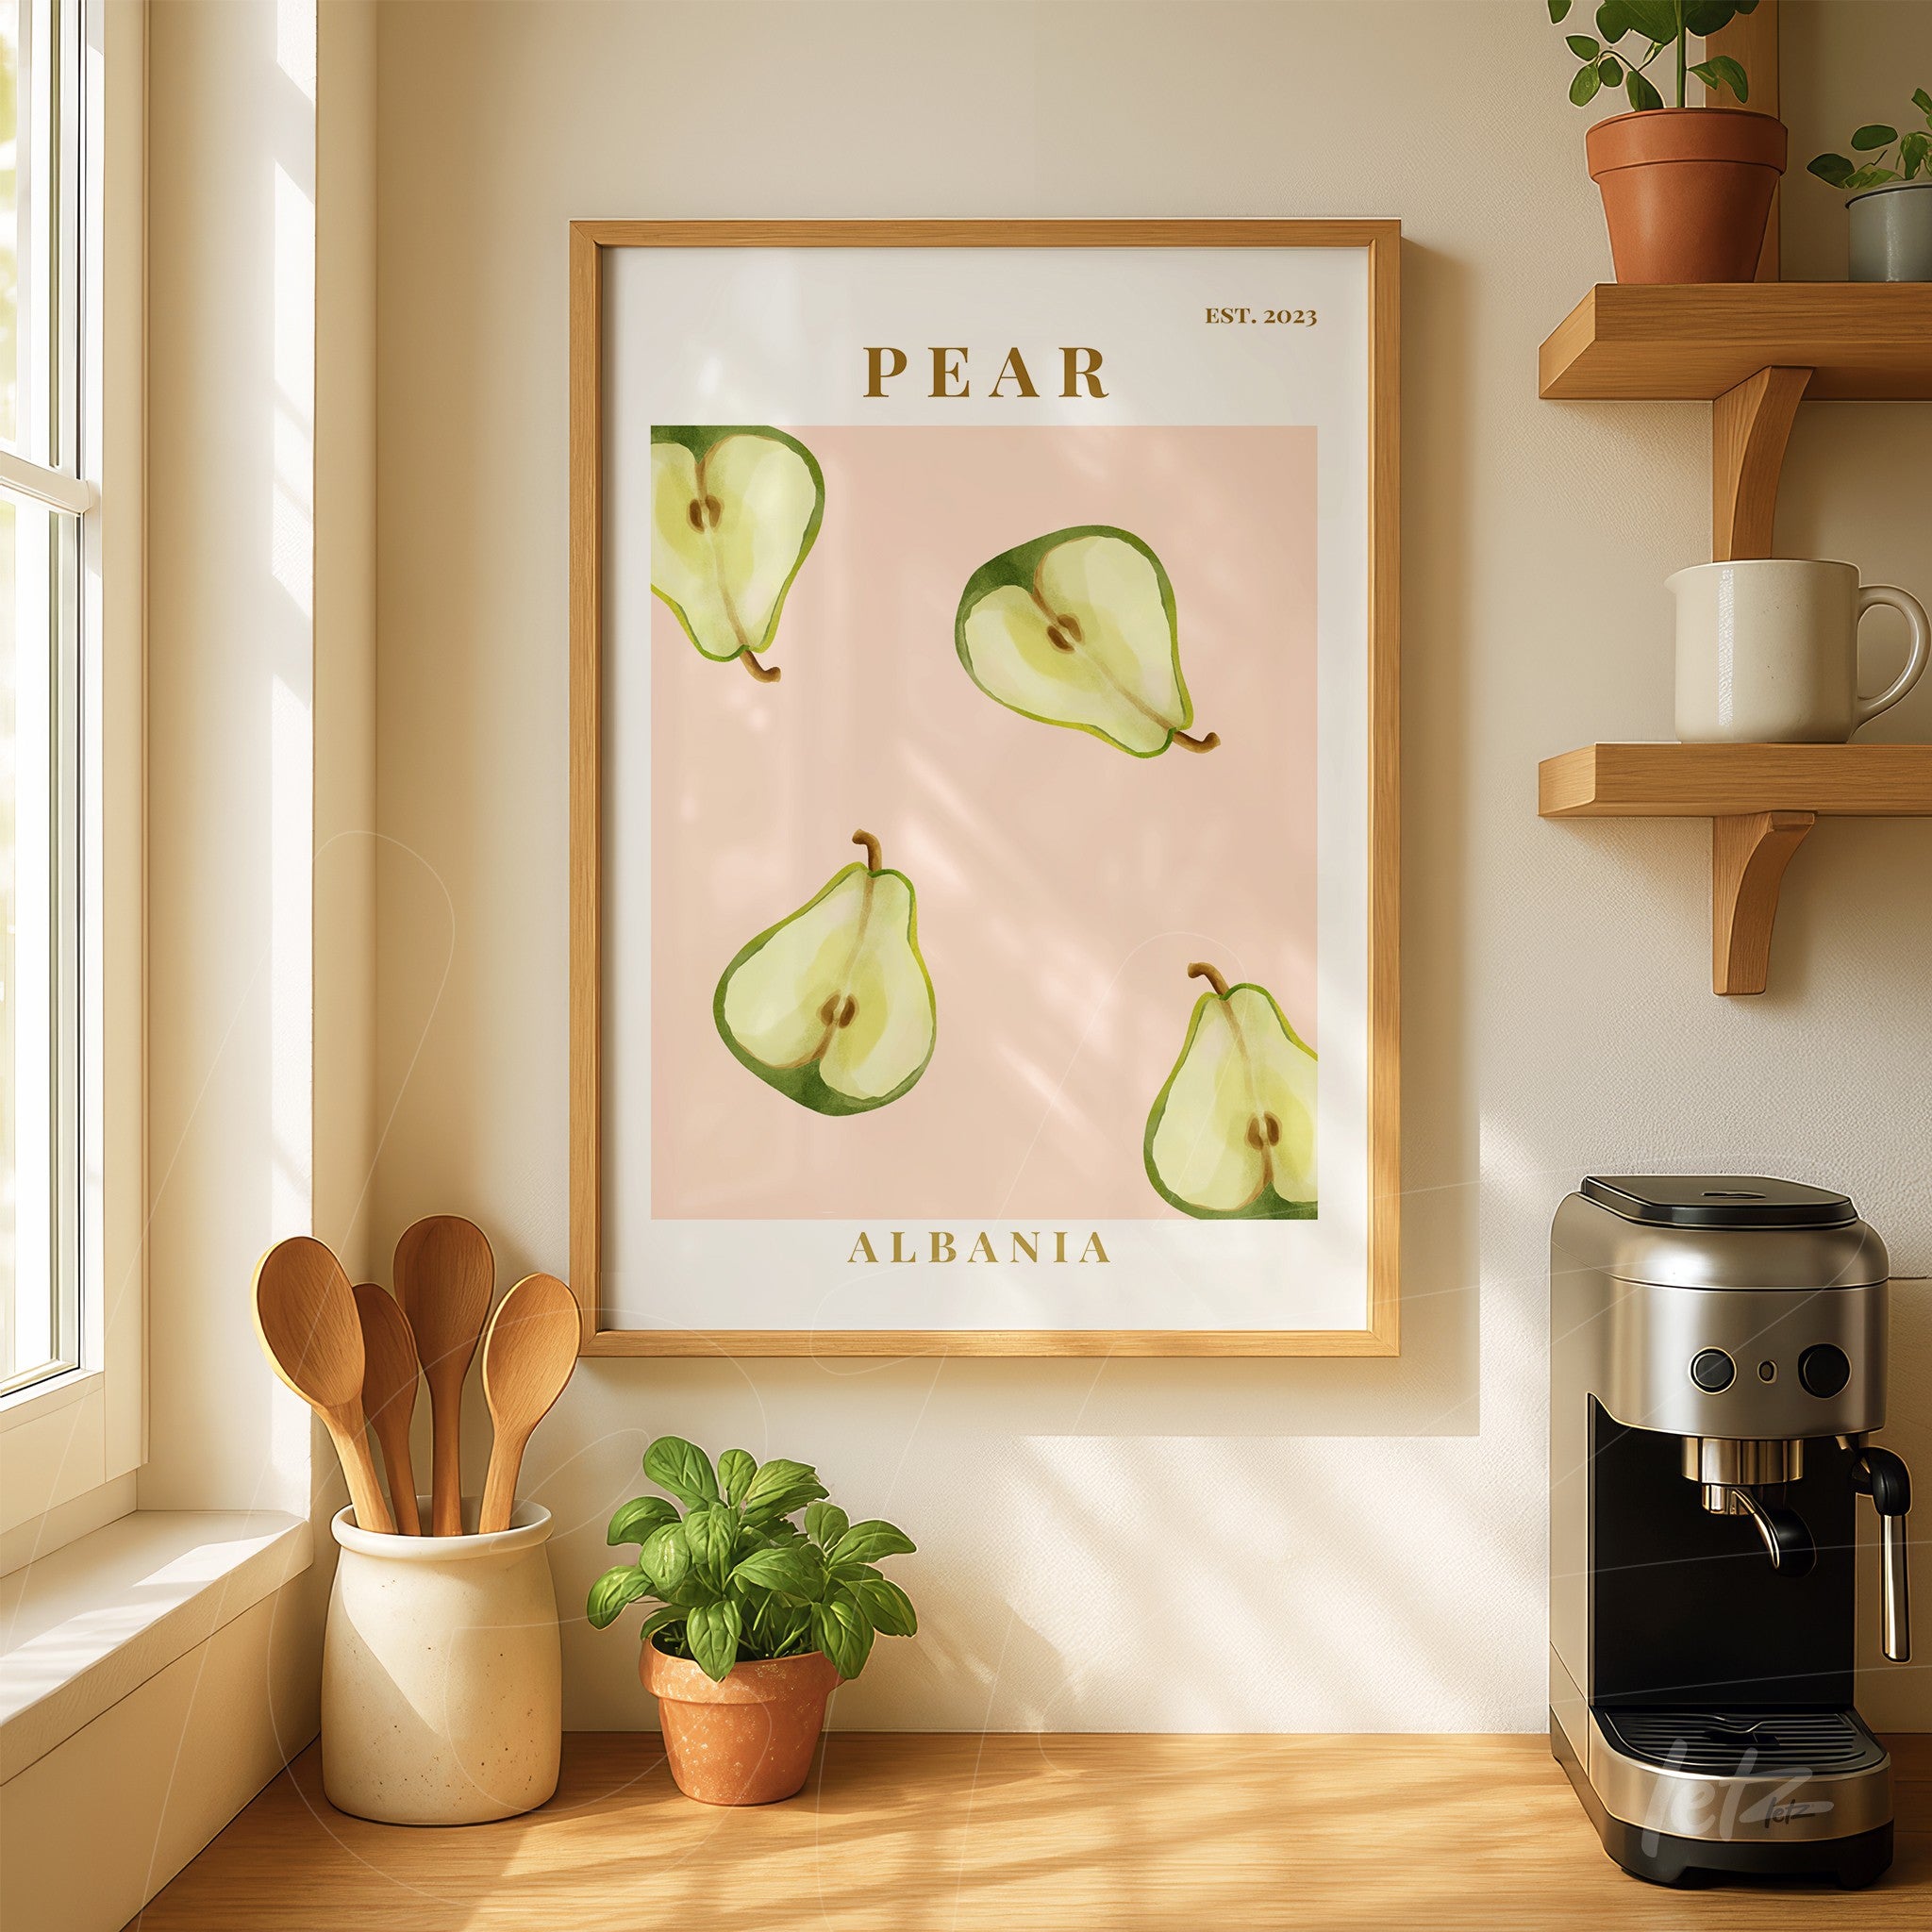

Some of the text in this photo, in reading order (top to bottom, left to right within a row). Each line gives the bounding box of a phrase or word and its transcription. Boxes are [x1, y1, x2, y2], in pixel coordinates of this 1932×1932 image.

[1206, 308, 1317, 326] EST. 2023
[862, 346, 1109, 399] PEAR
[847, 1231, 1110, 1263] ALBANIA
